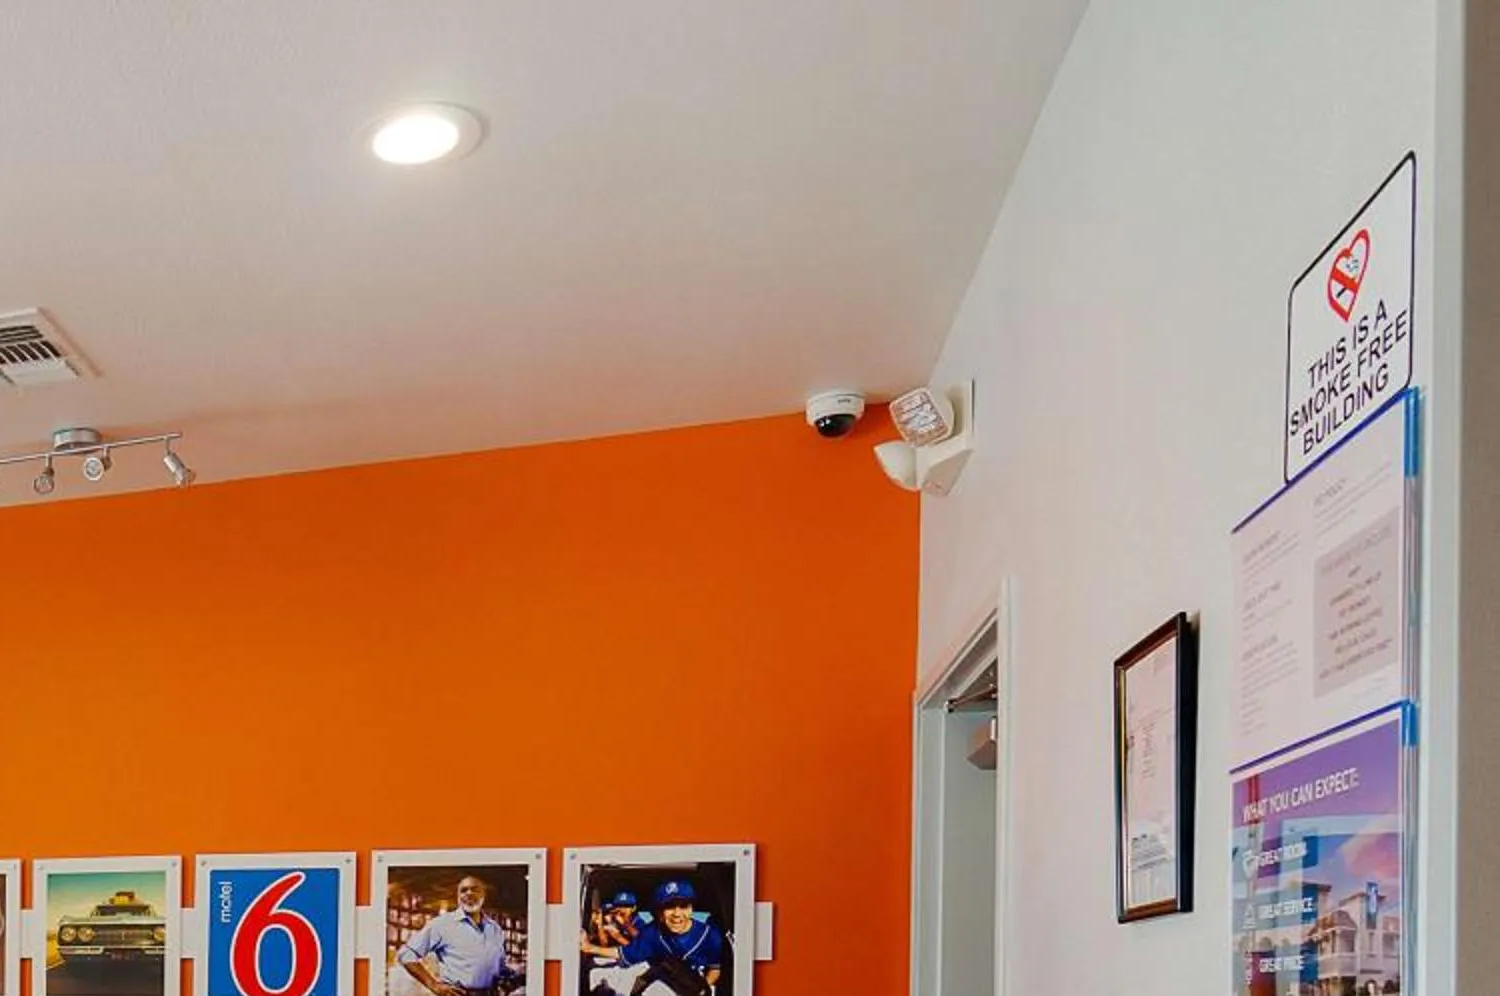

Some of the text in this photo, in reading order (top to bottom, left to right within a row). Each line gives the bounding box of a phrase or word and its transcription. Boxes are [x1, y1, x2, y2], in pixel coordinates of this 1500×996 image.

[1290, 310, 1407, 436] SMOKE FREE
[1308, 299, 1388, 388] THIS IS A
[1303, 363, 1389, 455] BUILDING
[1243, 798, 1268, 822] WHAT
[1269, 791, 1288, 814] YOU
[1291, 783, 1313, 807] CAN
[219, 881, 233, 922] motel
